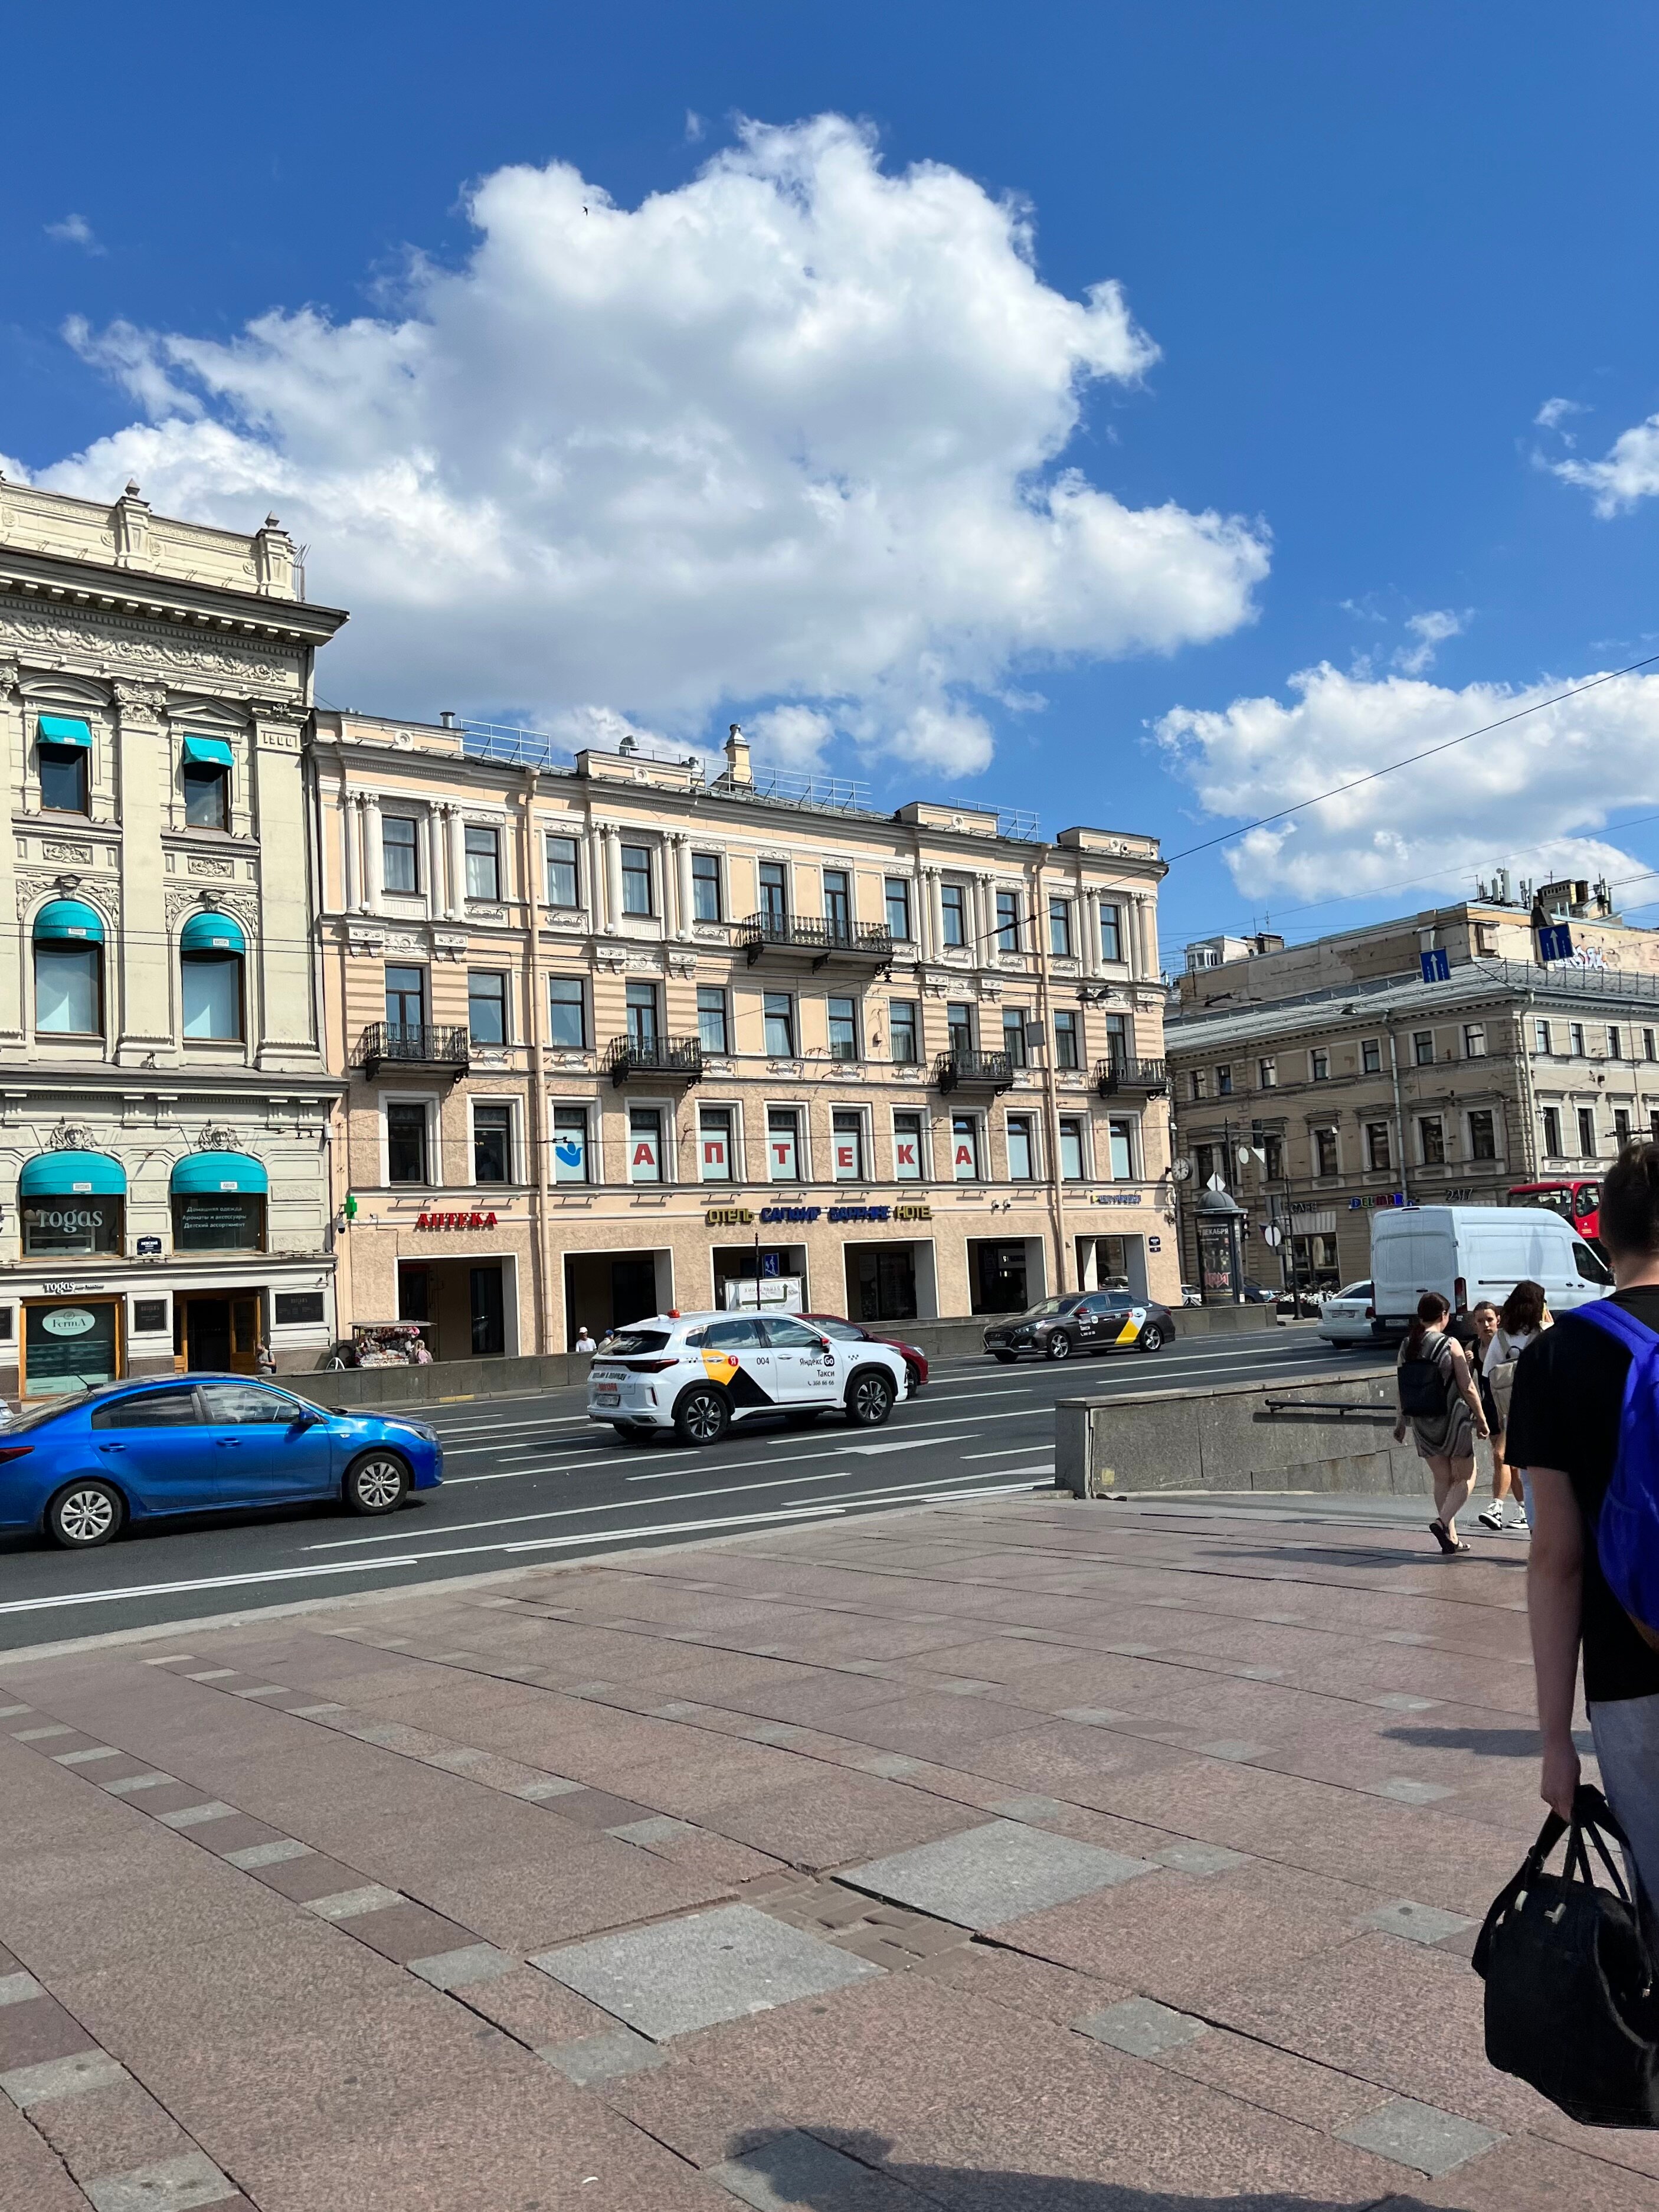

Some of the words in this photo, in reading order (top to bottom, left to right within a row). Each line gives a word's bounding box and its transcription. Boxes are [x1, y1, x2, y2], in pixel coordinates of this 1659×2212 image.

[417, 1212, 498, 1227] АПТЕКА
[708, 1208, 755, 1223] ОТЕЛЬ
[761, 1206, 822, 1222] САПФИР
[896, 1205, 935, 1219] HOTEL
[1202, 1228, 1229, 1236] ДЕКАБРЯ
[757, 1357, 770, 1365] 004
[799, 1358, 823, 1367] Яндекс
[824, 1356, 834, 1365] Go
